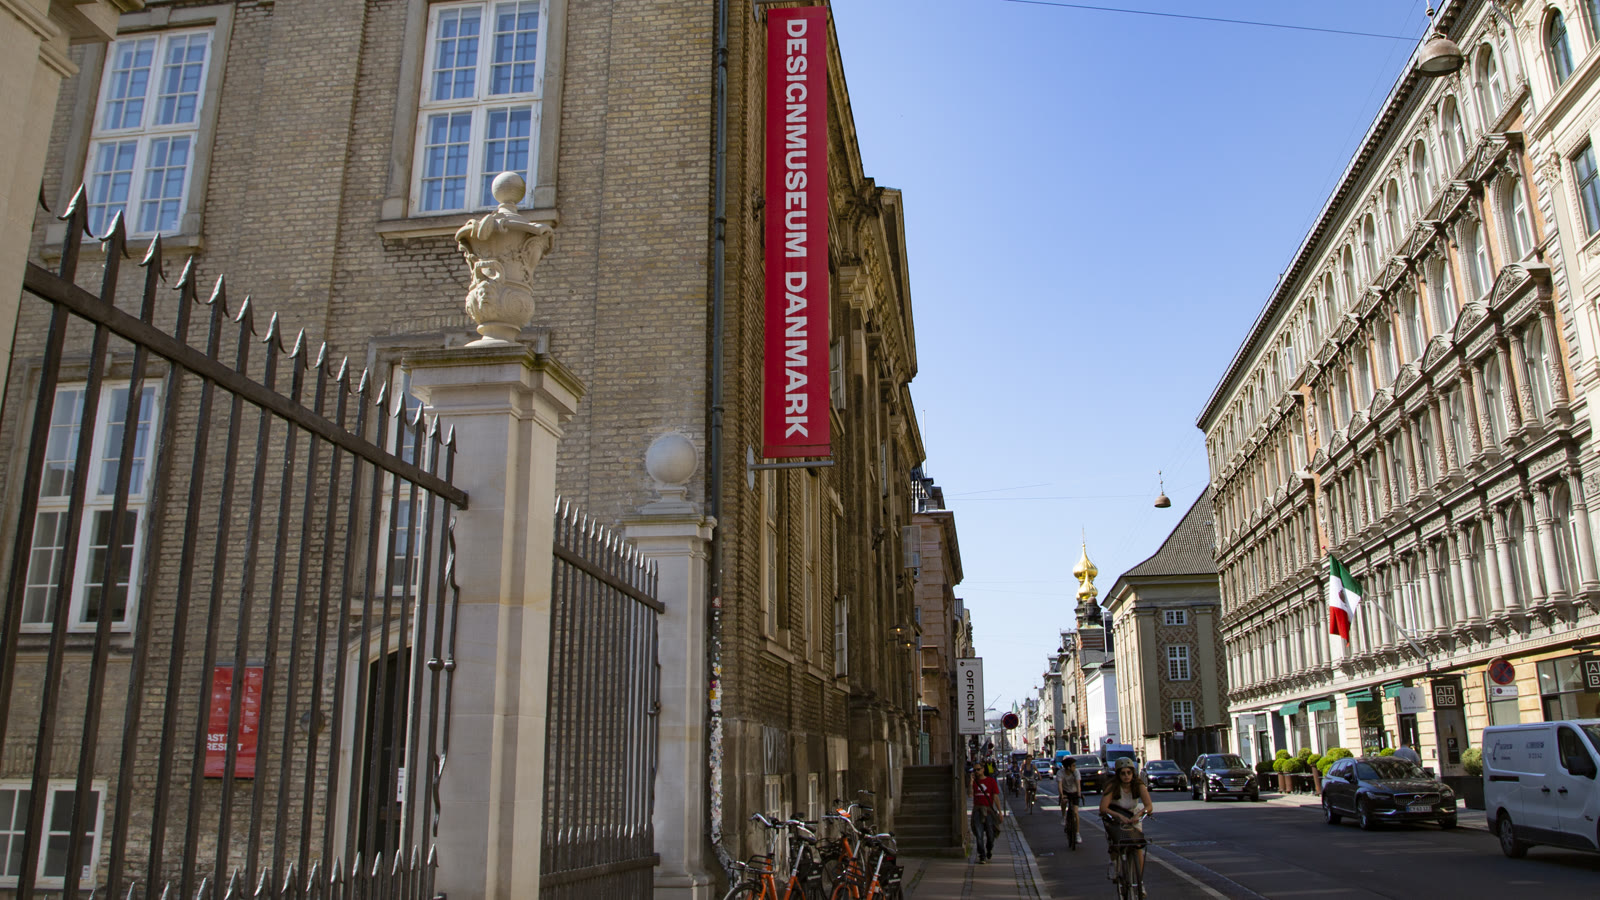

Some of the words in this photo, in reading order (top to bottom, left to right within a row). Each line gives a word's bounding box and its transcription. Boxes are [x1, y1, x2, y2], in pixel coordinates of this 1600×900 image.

[785, 18, 808, 259] DESIGNMUSEUM
[785, 271, 809, 439] DANMARK
[966, 670, 975, 723] OFFICINET
